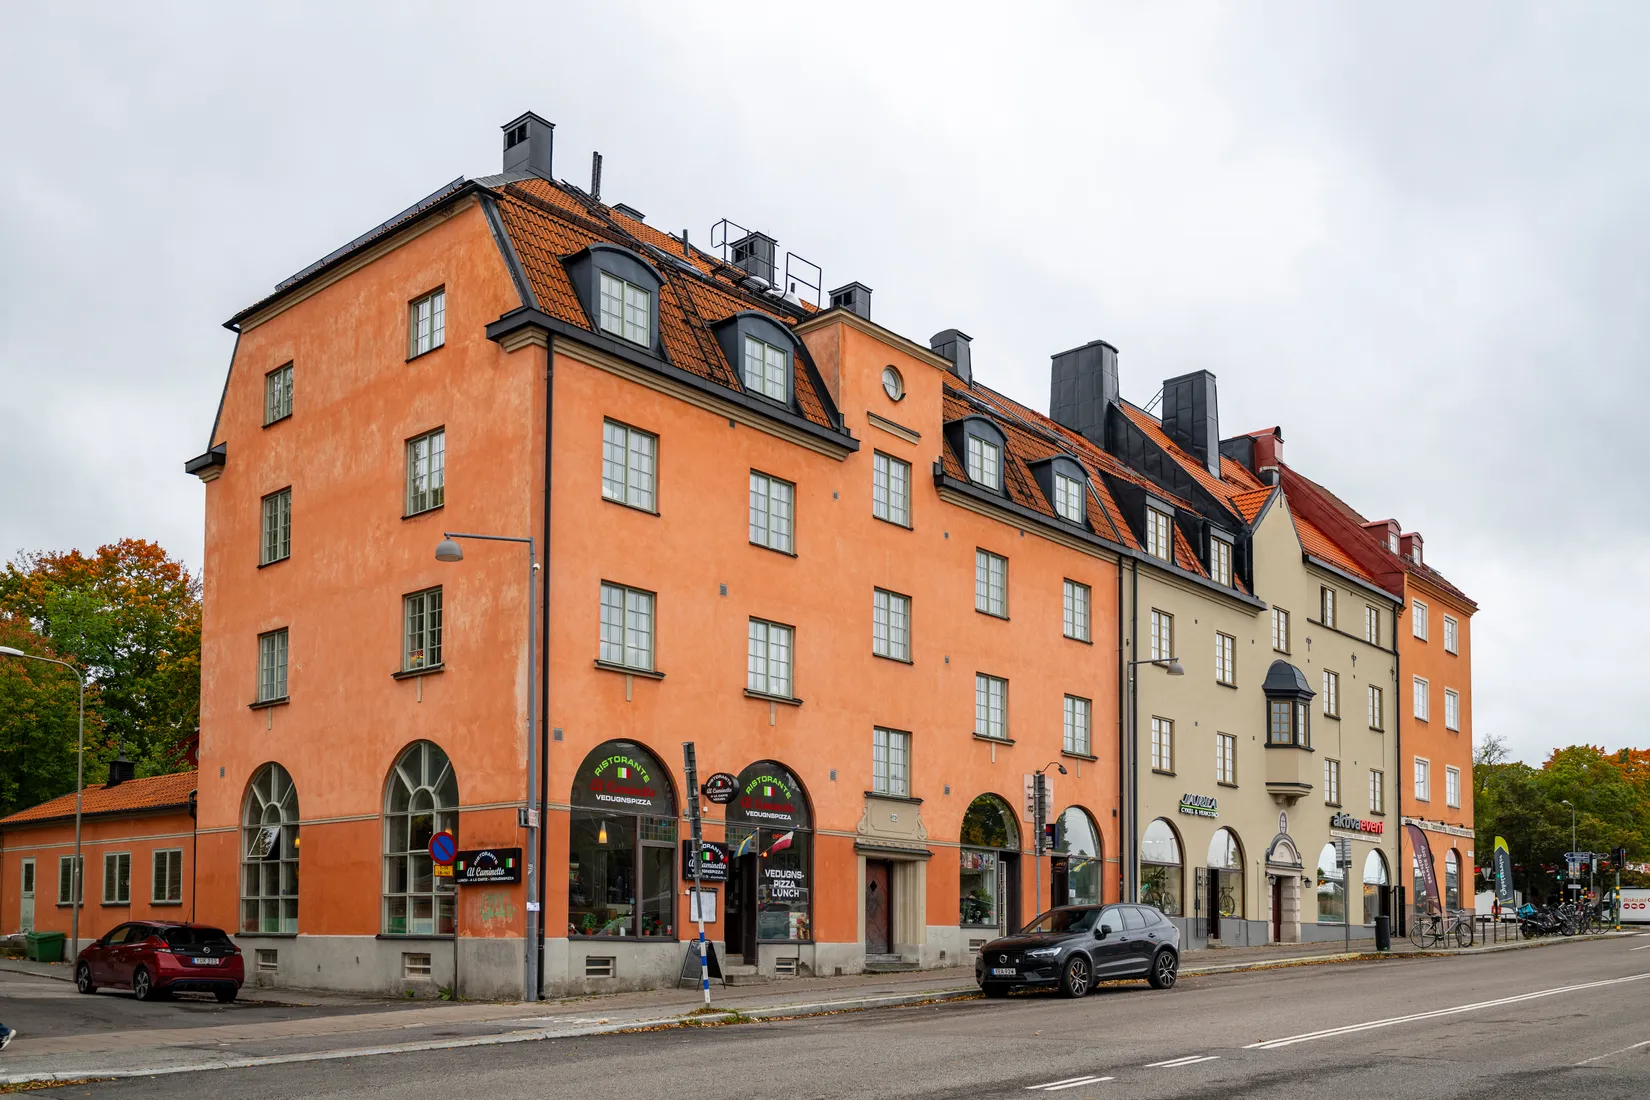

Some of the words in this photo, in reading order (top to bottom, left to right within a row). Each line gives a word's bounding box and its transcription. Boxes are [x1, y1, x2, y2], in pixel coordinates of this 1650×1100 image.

[594, 755, 650, 783] RISTORANTE
[707, 774, 732, 787] RISTORANTE
[745, 775, 792, 800] RISTORANTE
[595, 793, 652, 806] VEDUGNSPIZZA
[745, 810, 792, 821] VEDUGNSPIZZA
[474, 851, 499, 866] RISTORANTE
[467, 867, 475, 877] Al
[476, 867, 505, 876] Caminetto
[764, 868, 805, 879] VEDUGNS-
[773, 880, 796, 889] PIZZA
[772, 888, 800, 898] LUNCH
